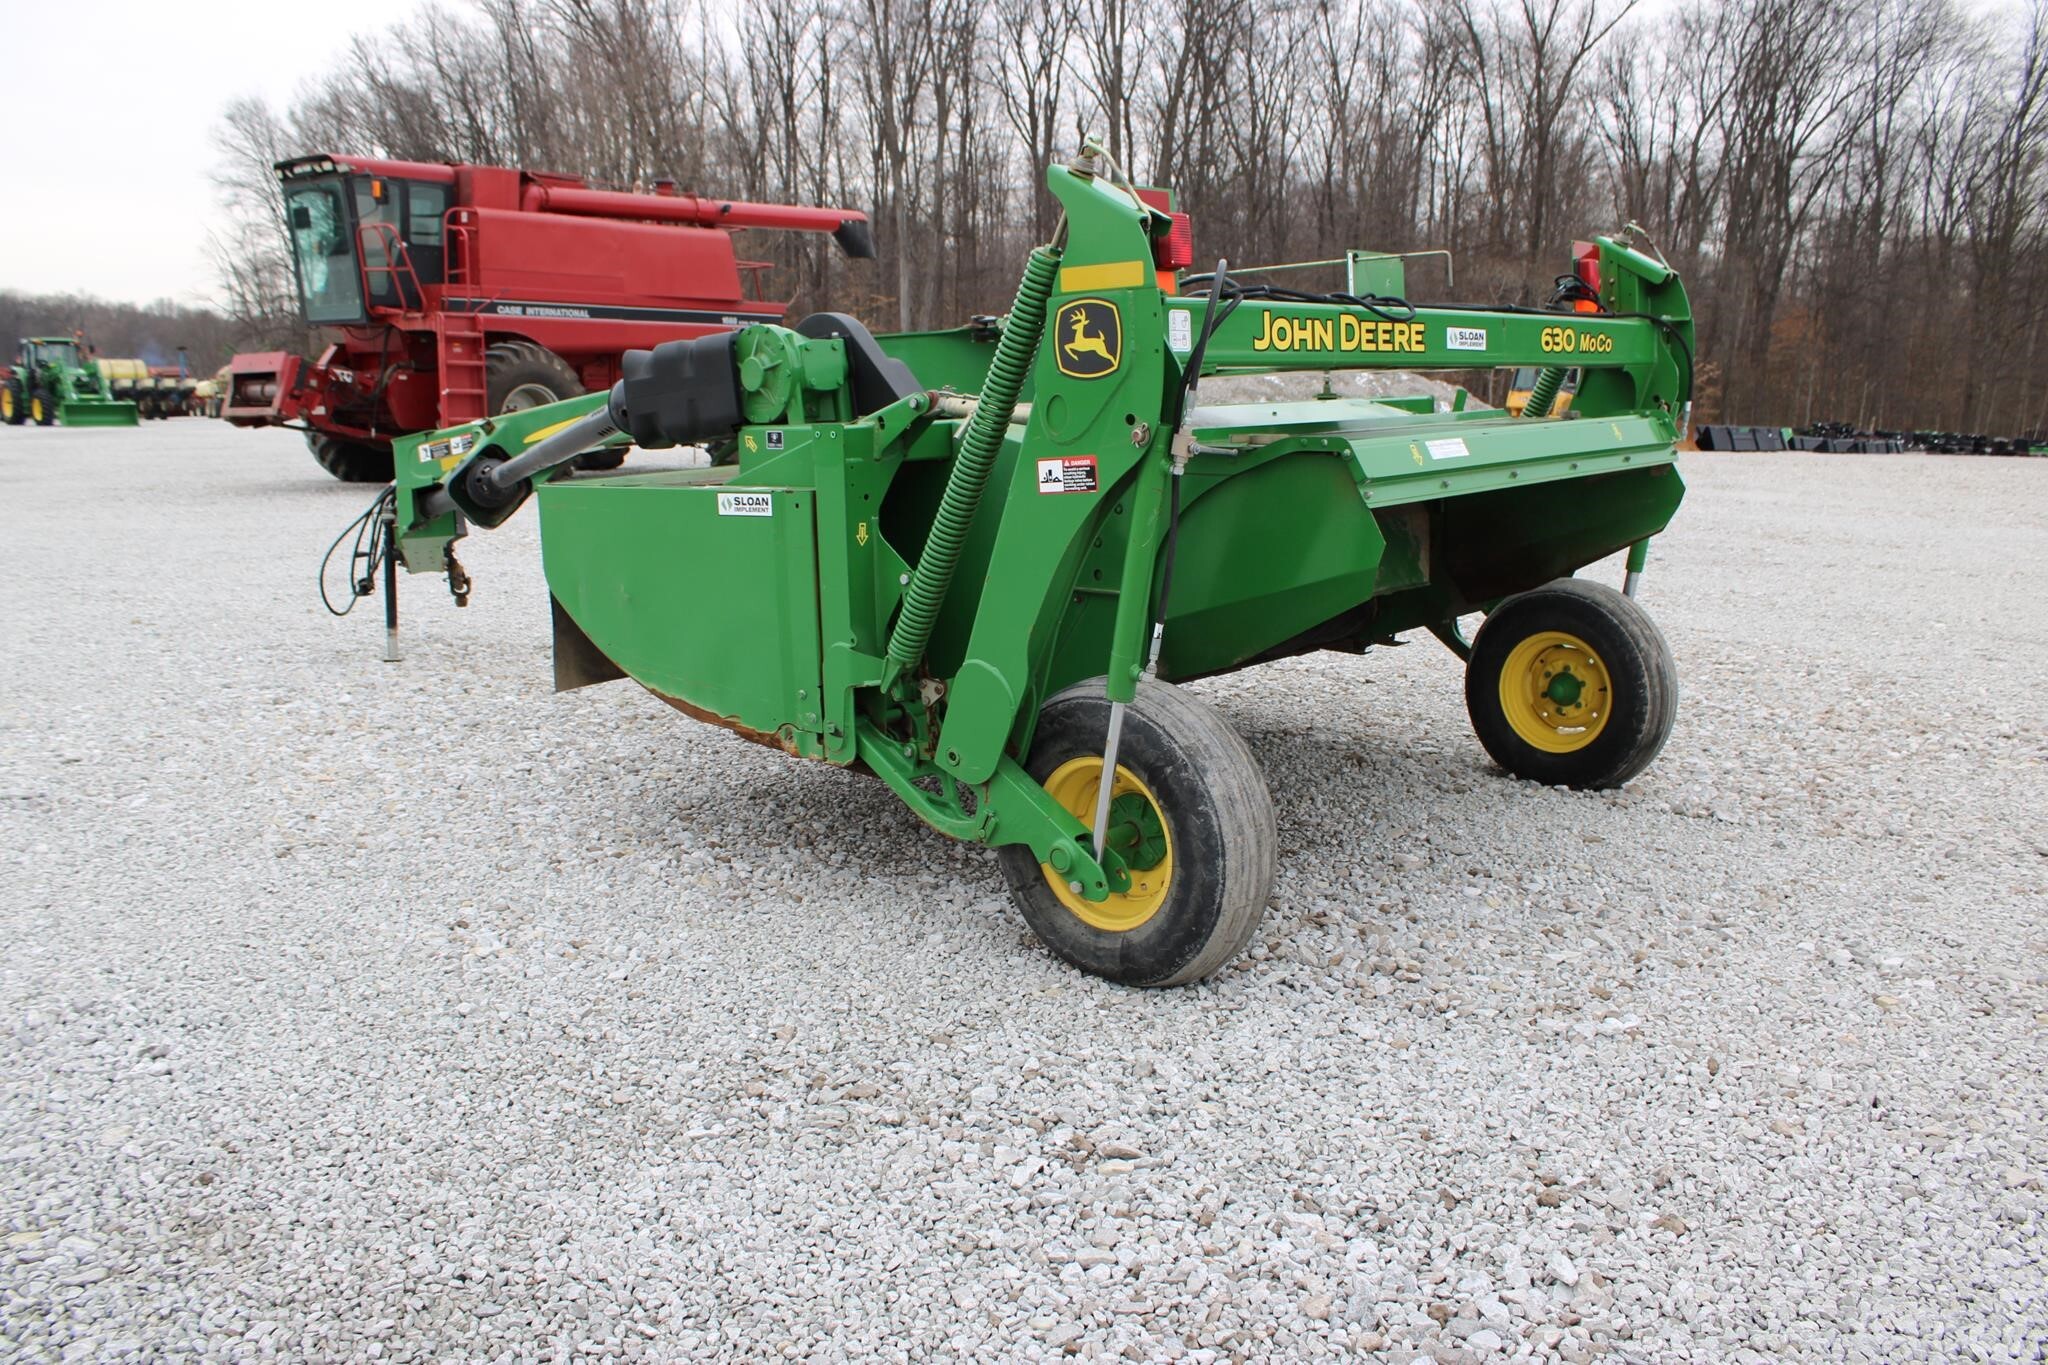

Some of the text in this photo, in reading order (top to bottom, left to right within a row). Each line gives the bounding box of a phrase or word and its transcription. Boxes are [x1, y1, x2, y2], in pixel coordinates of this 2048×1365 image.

[496, 304, 590, 318] CASE INTERNATIONAL
[1253, 309, 1426, 353] JOHN DEERE
[1458, 331, 1484, 341] SLOAN
[1541, 326, 1613, 353] 630 MoCo
[734, 496, 769, 506] SLOAN
